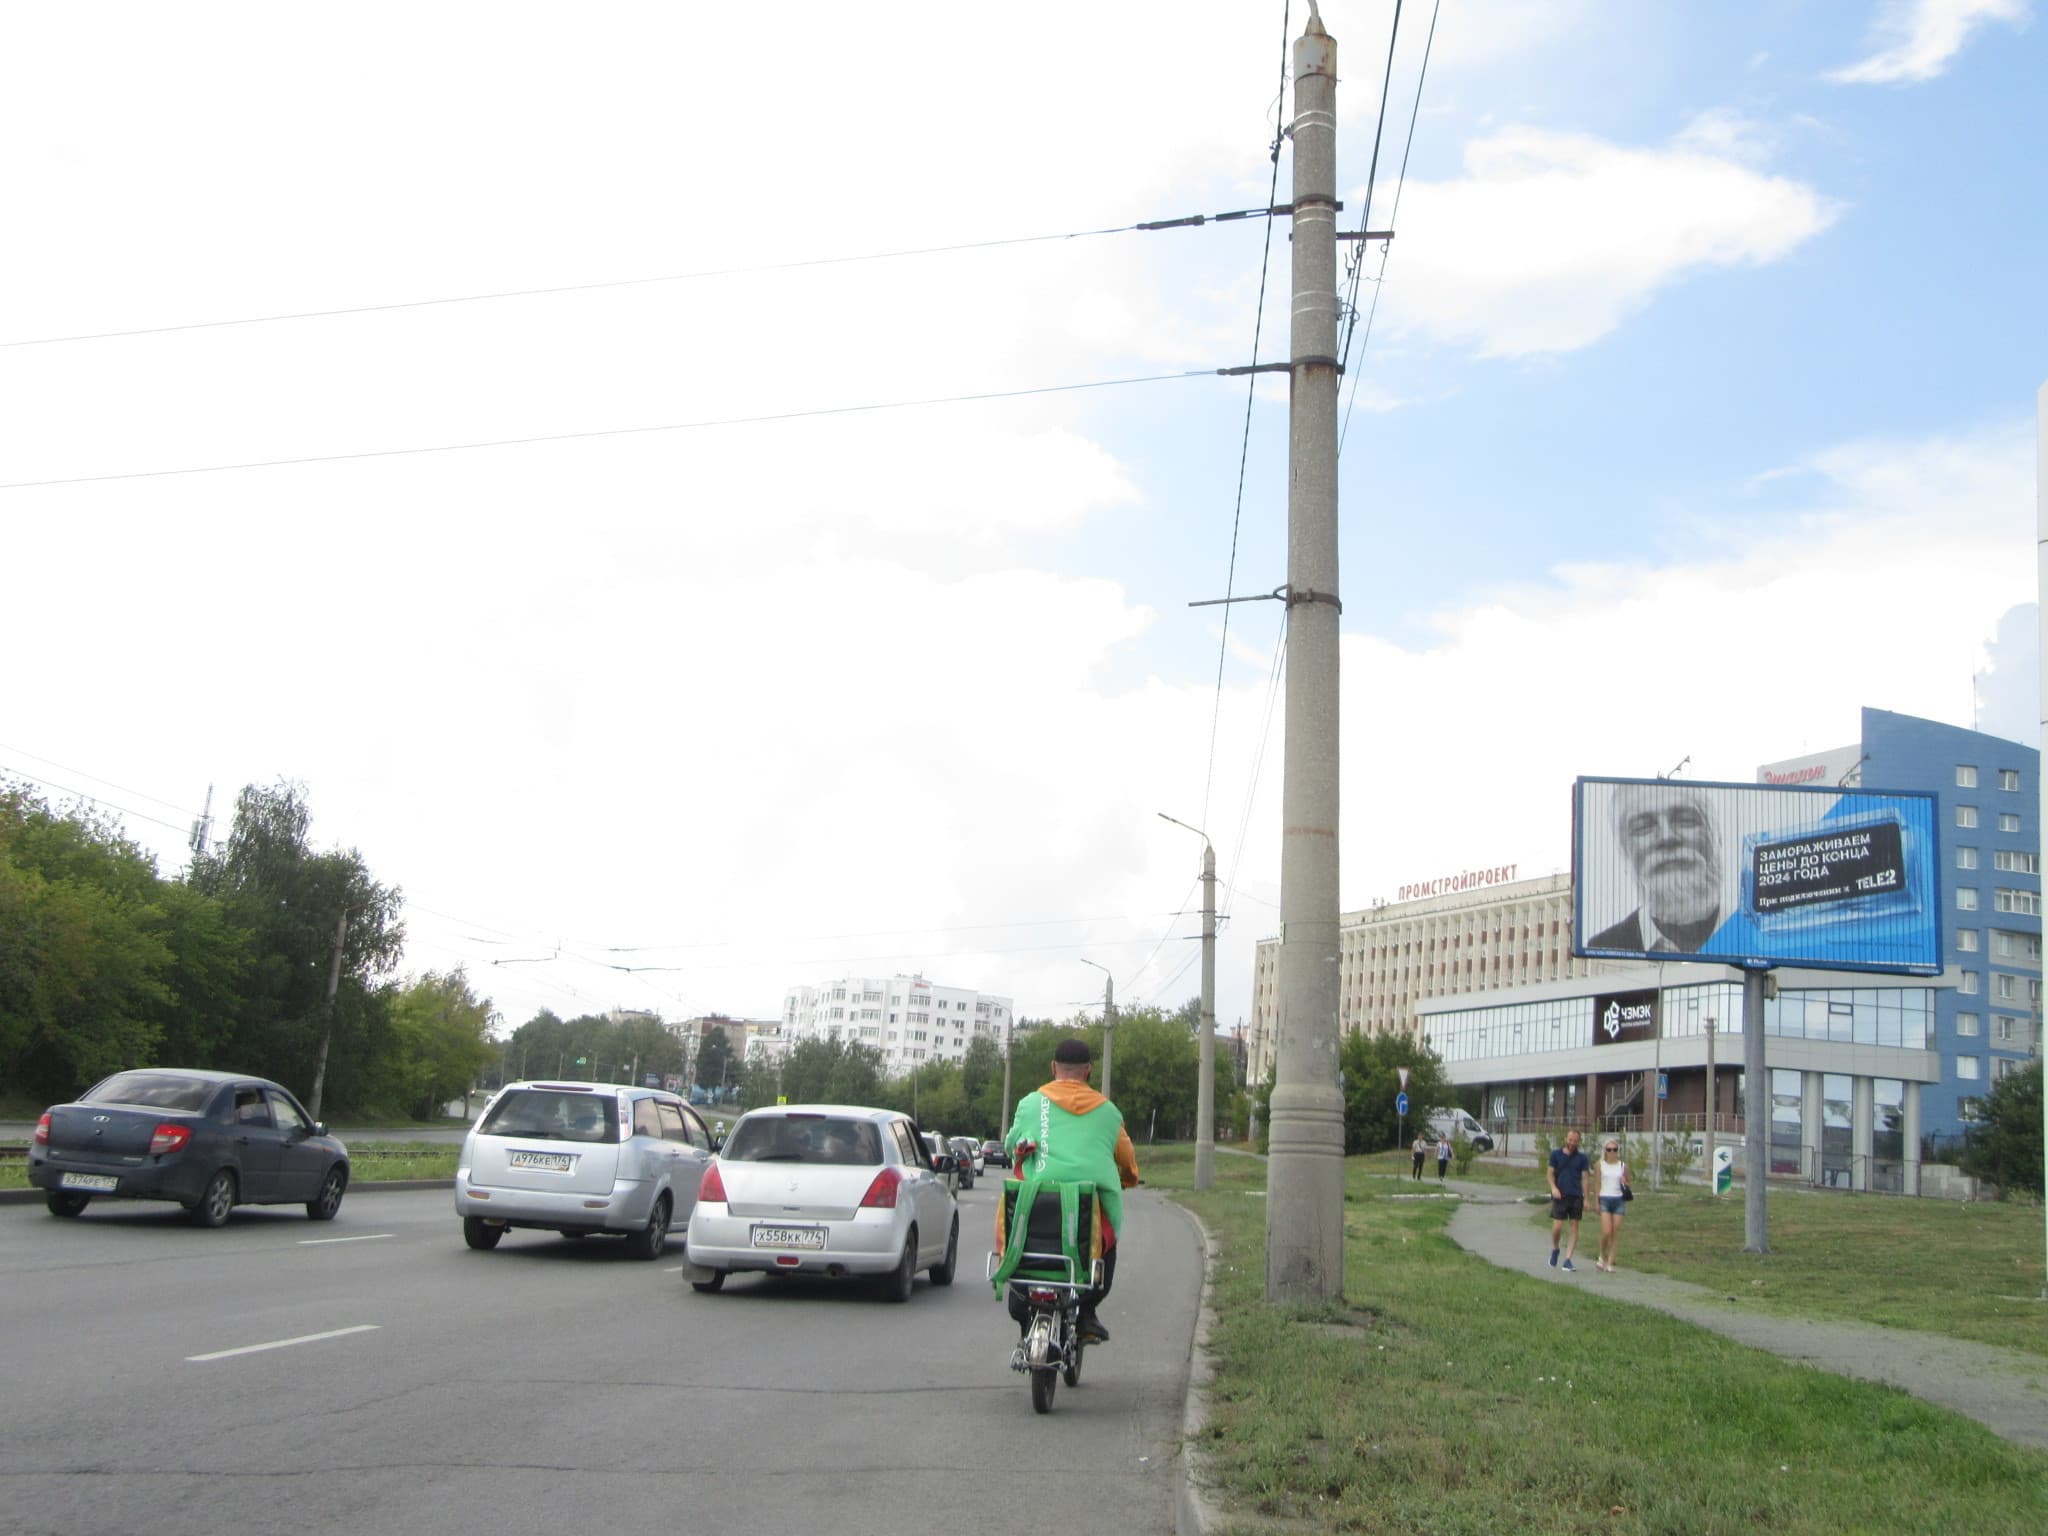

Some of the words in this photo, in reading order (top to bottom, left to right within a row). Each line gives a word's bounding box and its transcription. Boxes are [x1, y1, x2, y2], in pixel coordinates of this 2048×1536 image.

[1759, 858, 1797, 875] ЦЕНЫ
[1800, 855, 1819, 868] ДО
[1822, 847, 1869, 864] КОНЦА
[1760, 833, 1871, 862] ЗАМОРАЖИВАЕМ
[1398, 864, 1518, 900] ПРОМСТРОЙПРОЕКТ
[1759, 873, 1791, 887] 2024
[1794, 865, 1830, 881] ГОДА
[1759, 896, 1778, 907] При
[1780, 887, 1842, 904] подключении
[1856, 869, 1897, 890] TELE2
